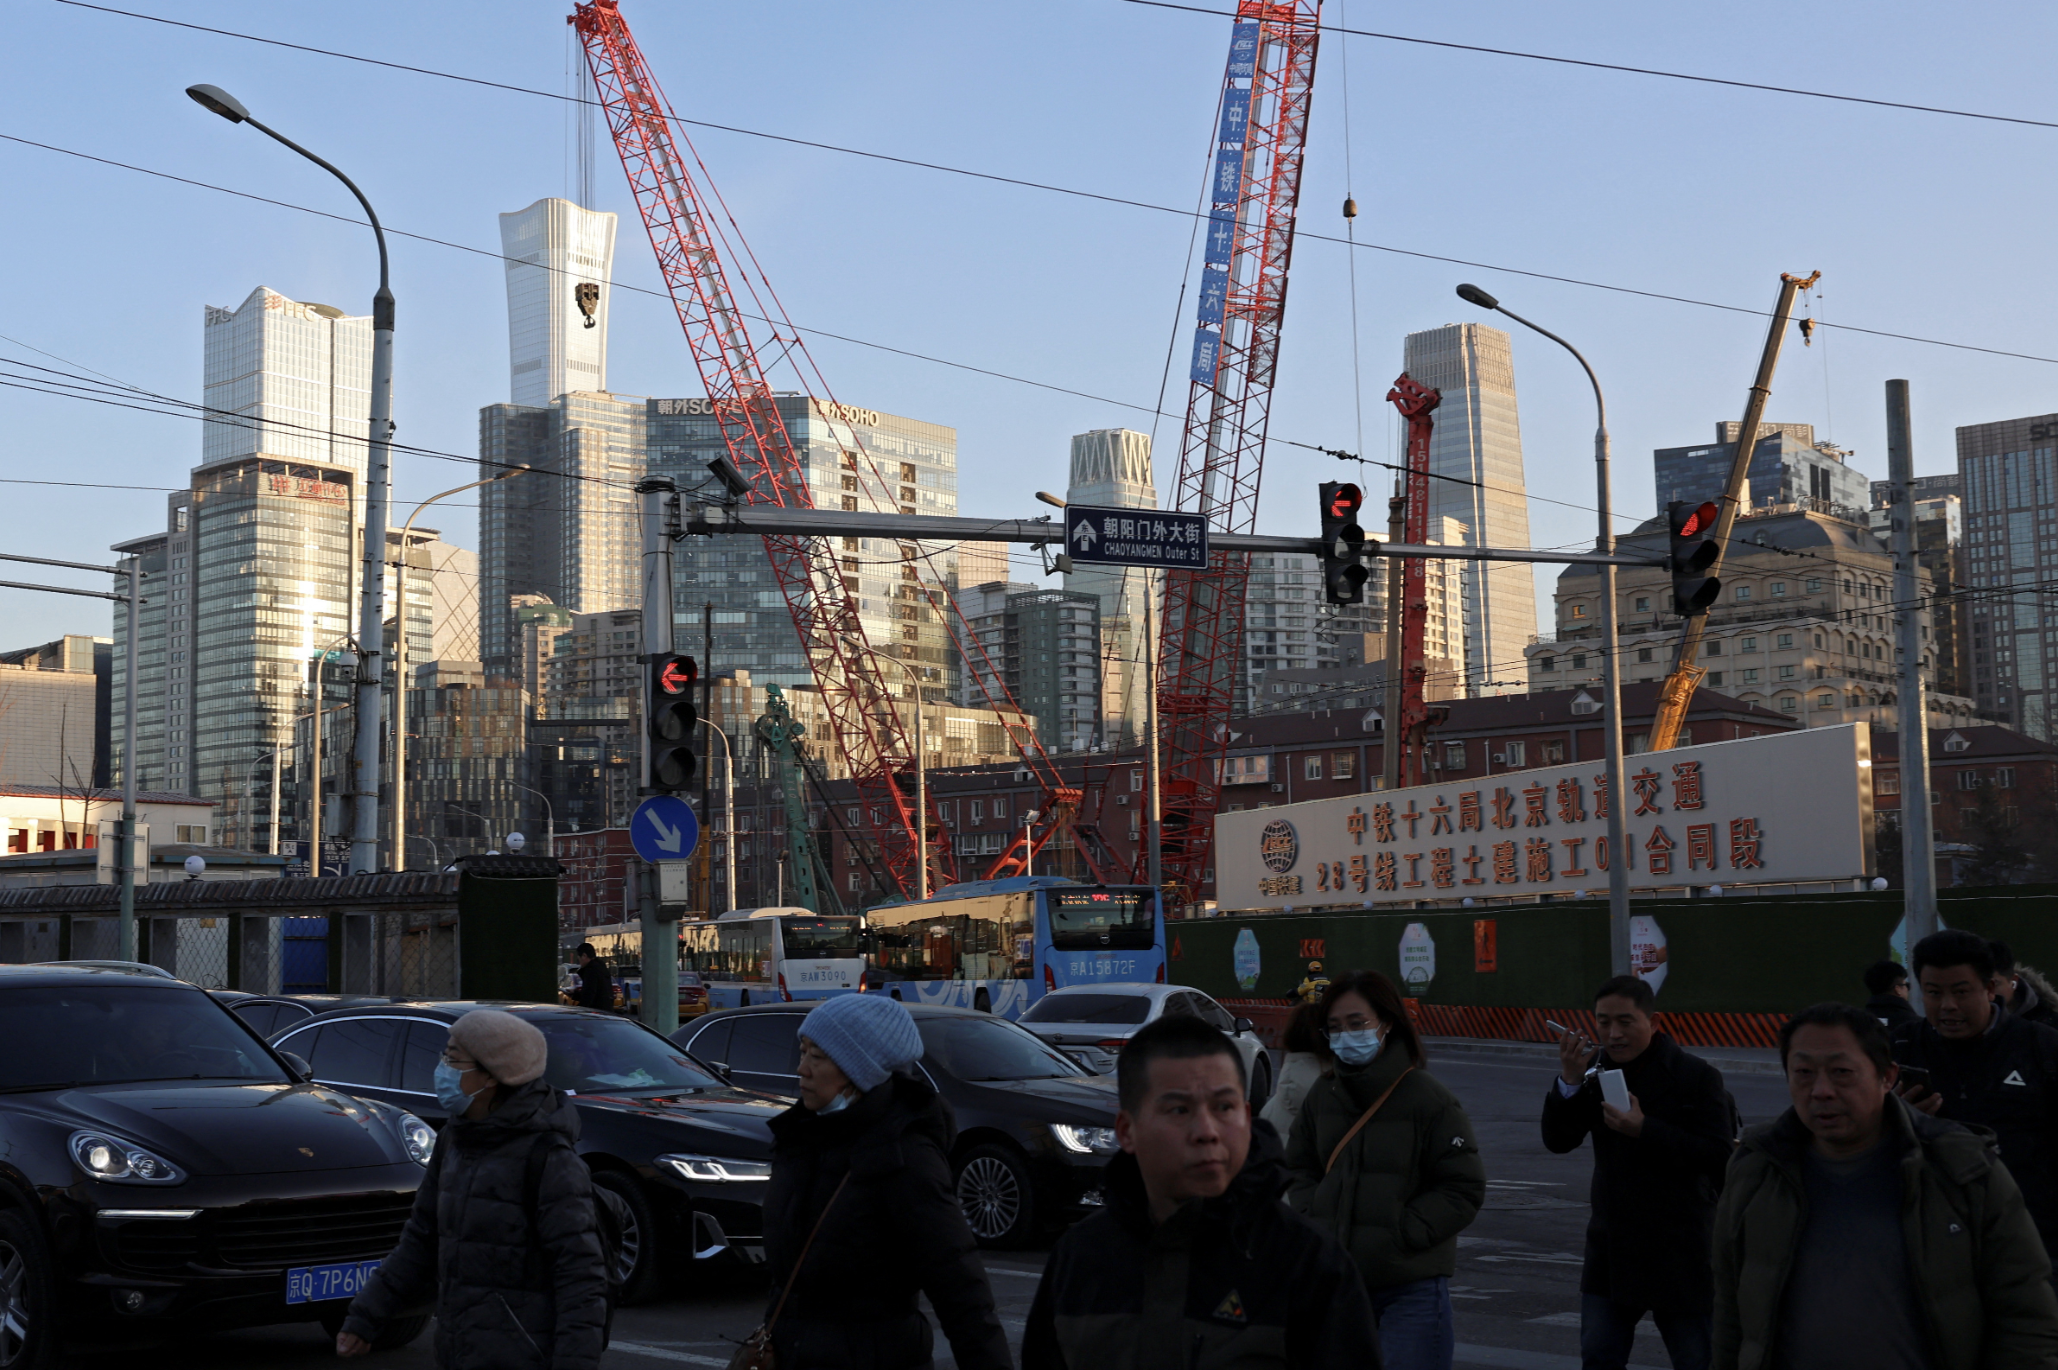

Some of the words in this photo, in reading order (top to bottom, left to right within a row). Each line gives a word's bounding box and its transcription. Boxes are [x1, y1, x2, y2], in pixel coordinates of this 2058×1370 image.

[1197, 102, 1243, 373] 中铁十六局
[205, 305, 231, 326] FFC
[283, 300, 317, 322] FFC
[818, 400, 880, 428] 朝外SOHO
[1081, 523, 1090, 533] 东
[1082, 534, 1088, 542] E
[1103, 517, 1200, 544] 朝阳门外大街
[1104, 542, 1162, 559] CHAOYANGMEN
[1165, 545, 1188, 560] Outer
[1190, 547, 1200, 561] St
[1258, 875, 1301, 896] 中国铁建
[800, 971, 847, 982] 京AW3090
[1070, 960, 1136, 976] 京A15872F
